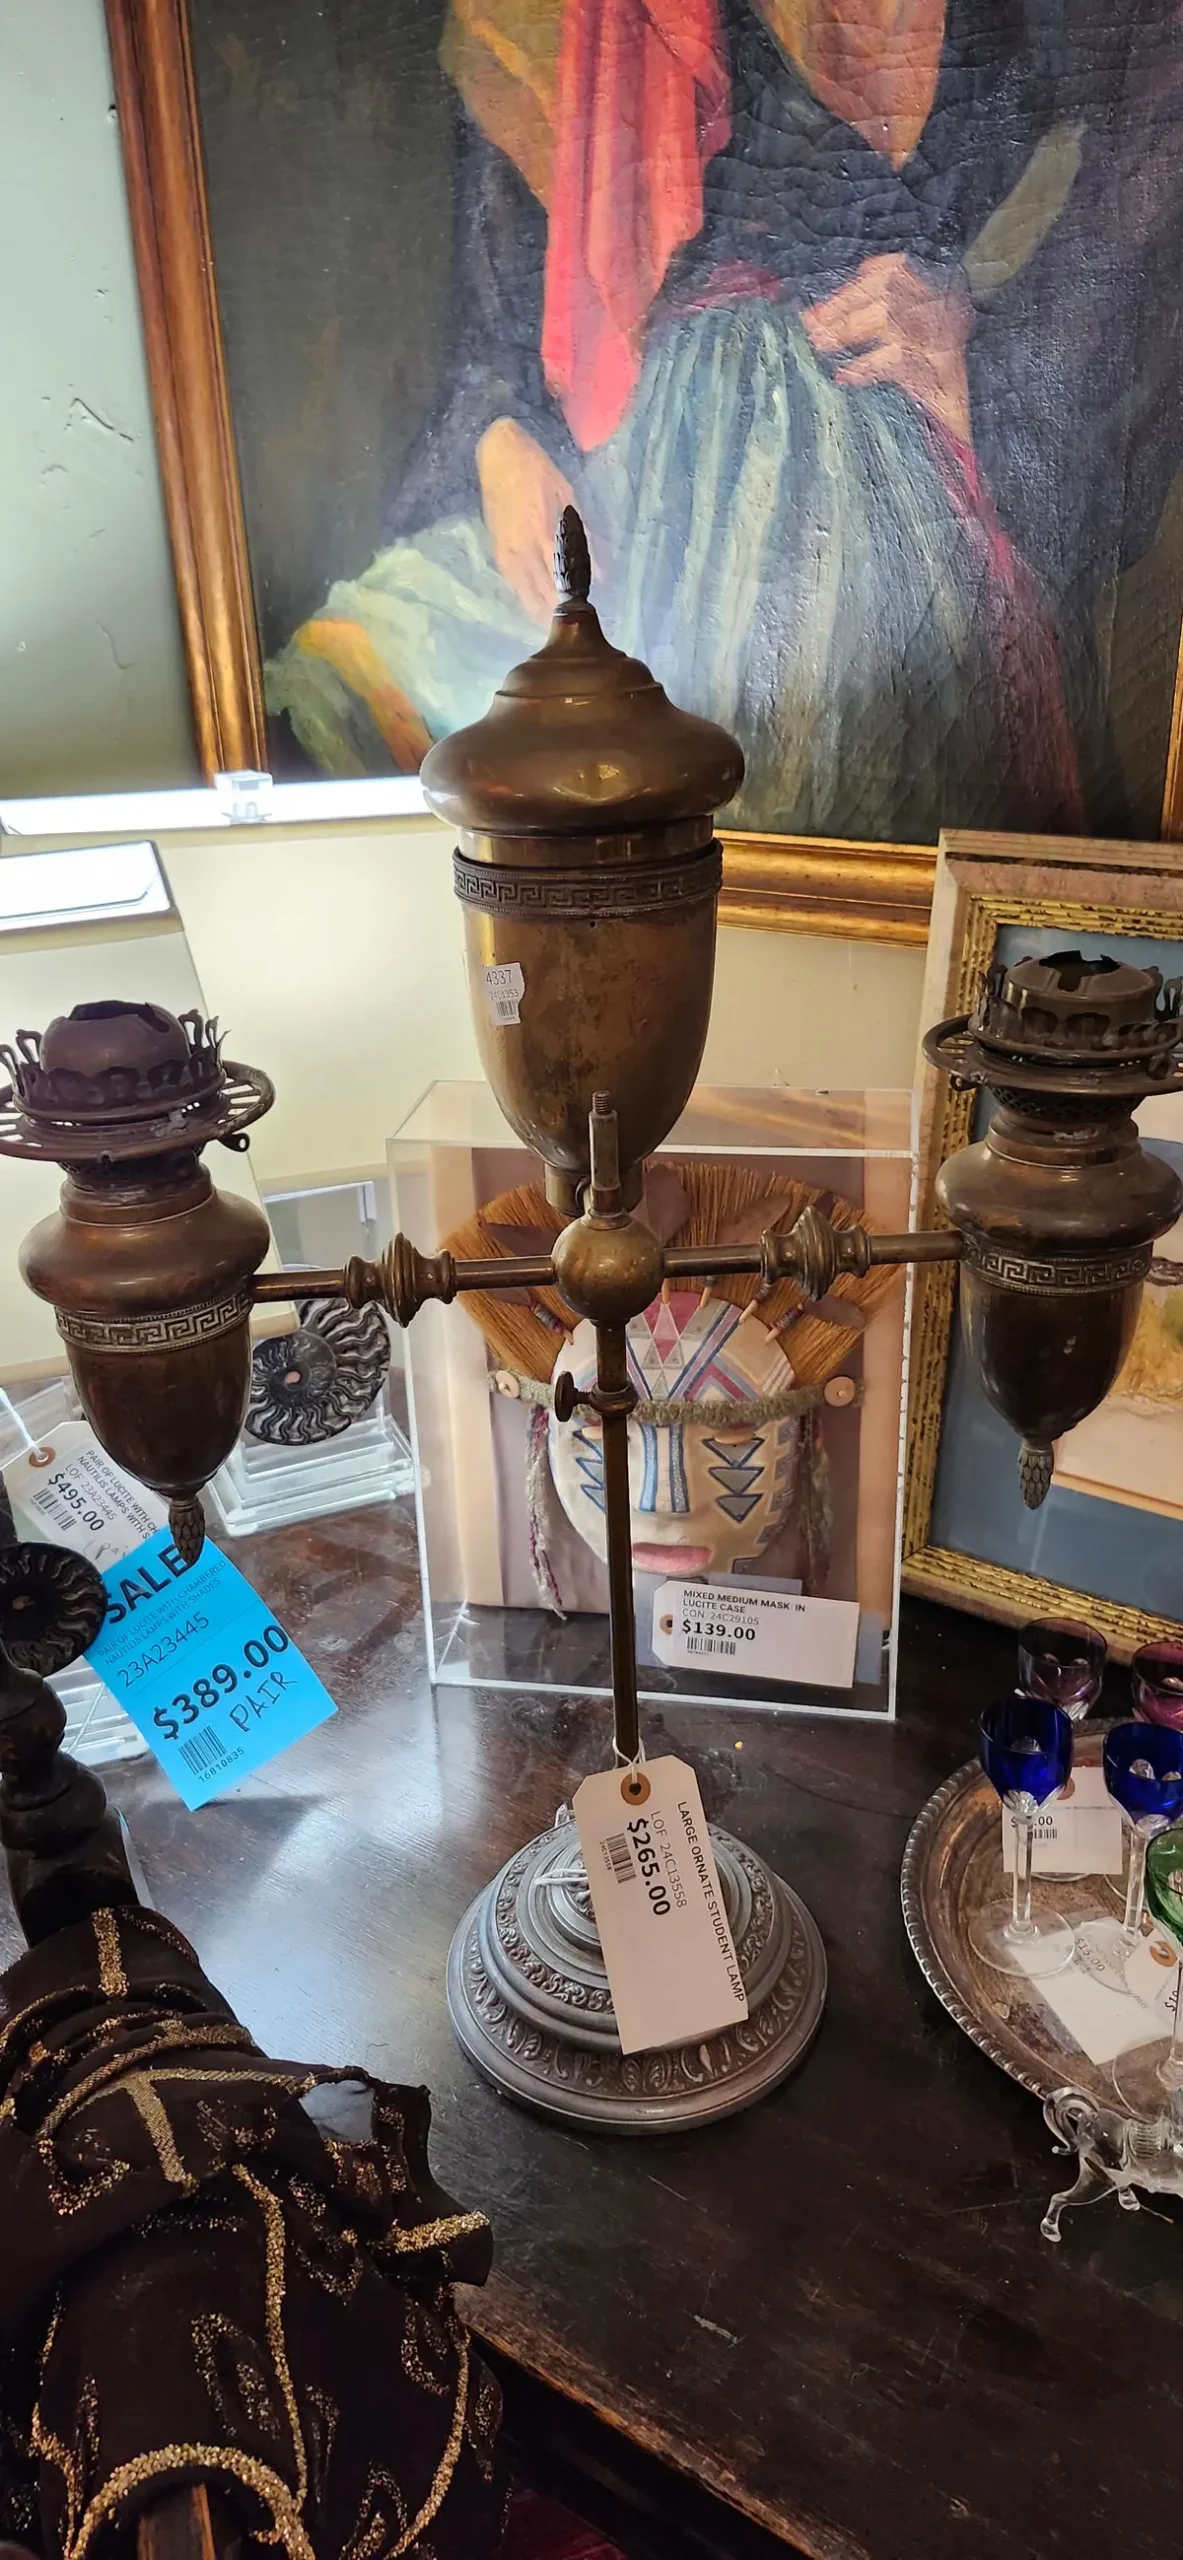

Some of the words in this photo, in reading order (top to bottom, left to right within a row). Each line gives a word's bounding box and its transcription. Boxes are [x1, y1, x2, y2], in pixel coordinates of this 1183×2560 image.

[486, 970, 512, 985] 4337
[48, 1472, 105, 1532] $495.00
[65, 1463, 86, 1481] LOF
[81, 1481, 118, 1521] 23A23445
[77, 1456, 111, 1490] NAUTILIS
[104, 1487, 128, 1515] LAMPS
[125, 1512, 144, 1534] WITH
[86, 1449, 105, 1469] PAIR
[101, 1467, 114, 1481] OF
[109, 1475, 135, 1503] LUCITE
[131, 1499, 150, 1523] WITH
[99, 1638, 120, 1657] PAIR
[117, 1632, 128, 1643] OF
[130, 1611, 158, 1635] LUCITE
[156, 1594, 181, 1615] WITH
[179, 1560, 227, 1598] CHAMBERED
[105, 1637, 142, 1666] NAUTILIS
[141, 1617, 169, 1641] LAMPS
[167, 1600, 190, 1621] WITH
[188, 1577, 221, 1605] SHADES
[681, 1618, 756, 1641] $139.00
[682, 1608, 705, 1618] CON
[710, 1611, 759, 1626] 24C29105
[683, 1589, 715, 1600] MIXED
[717, 1593, 758, 1606] MEDIUM
[760, 1598, 790, 1610] MASK
[795, 1603, 806, 1612] IN
[683, 1599, 717, 1610] LUCITE
[719, 1603, 746, 1614] CASE
[117, 1611, 209, 1688] 23A23445
[153, 1625, 288, 1740] $389.00
[229, 1671, 298, 1733] PAIR
[198, 1746, 245, 1783] 16810835
[627, 1817, 671, 1916] $265.00
[650, 1811, 668, 1837] LOF
[660, 1843, 687, 1908] 24C13558
[676, 1801, 699, 1845] LARGE
[690, 1846, 715, 1899] ORNATE
[707, 1900, 734, 1963] STUDENT
[725, 1960, 745, 2003] LAMP
